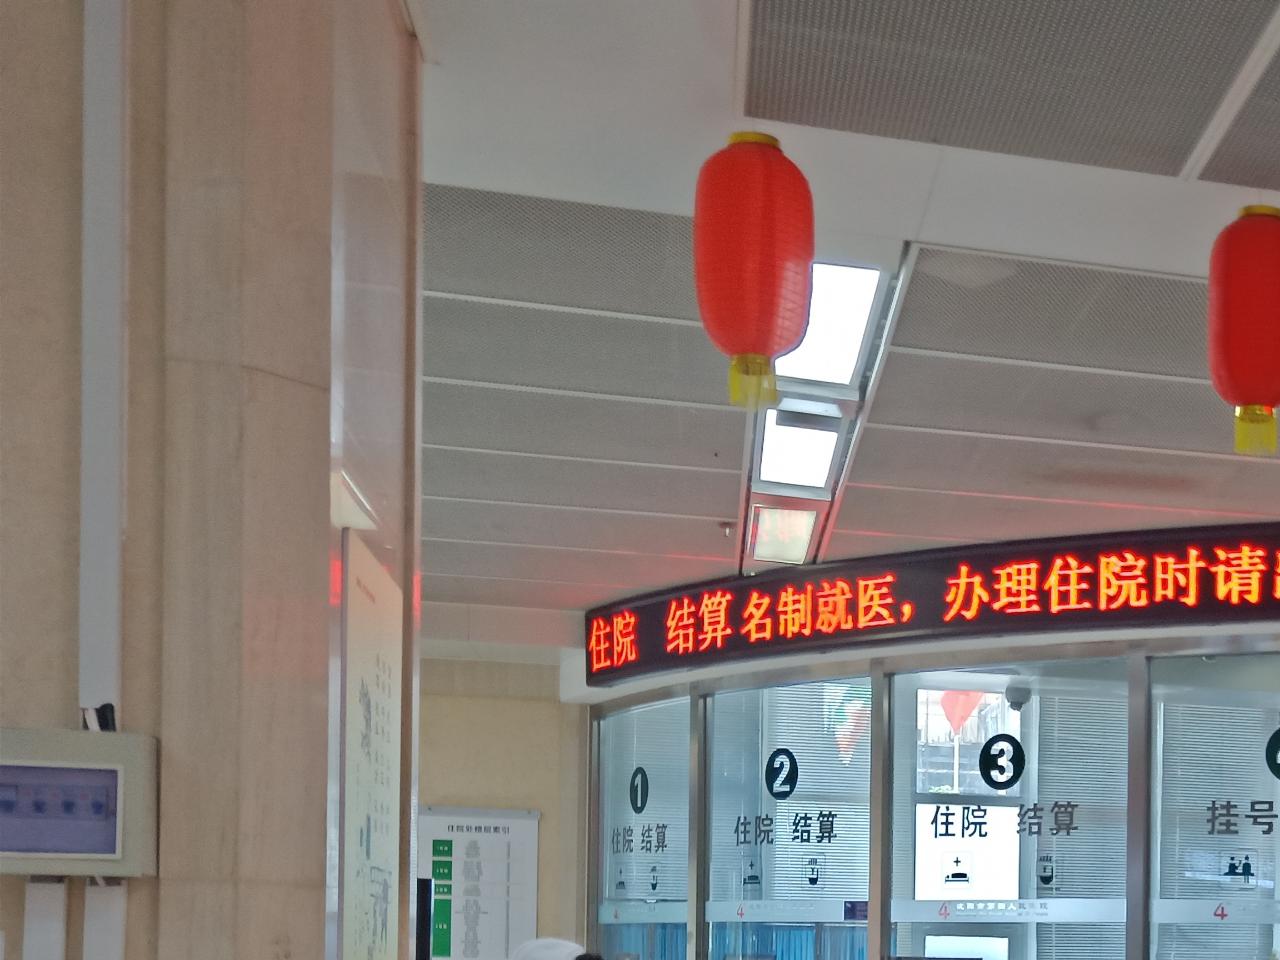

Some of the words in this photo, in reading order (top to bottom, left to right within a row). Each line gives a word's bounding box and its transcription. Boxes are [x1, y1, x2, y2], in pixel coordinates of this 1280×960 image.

[589, 611, 637, 672] 住院
[666, 590, 733, 654] 结算
[734, 814, 775, 846] 住院
[791, 811, 839, 844] 结算
[930, 804, 989, 838] 住院
[1016, 801, 1080, 836] 结算
[1206, 800, 1279, 835] 挂号
[611, 826, 634, 855] 住院
[640, 823, 669, 854] 结算
